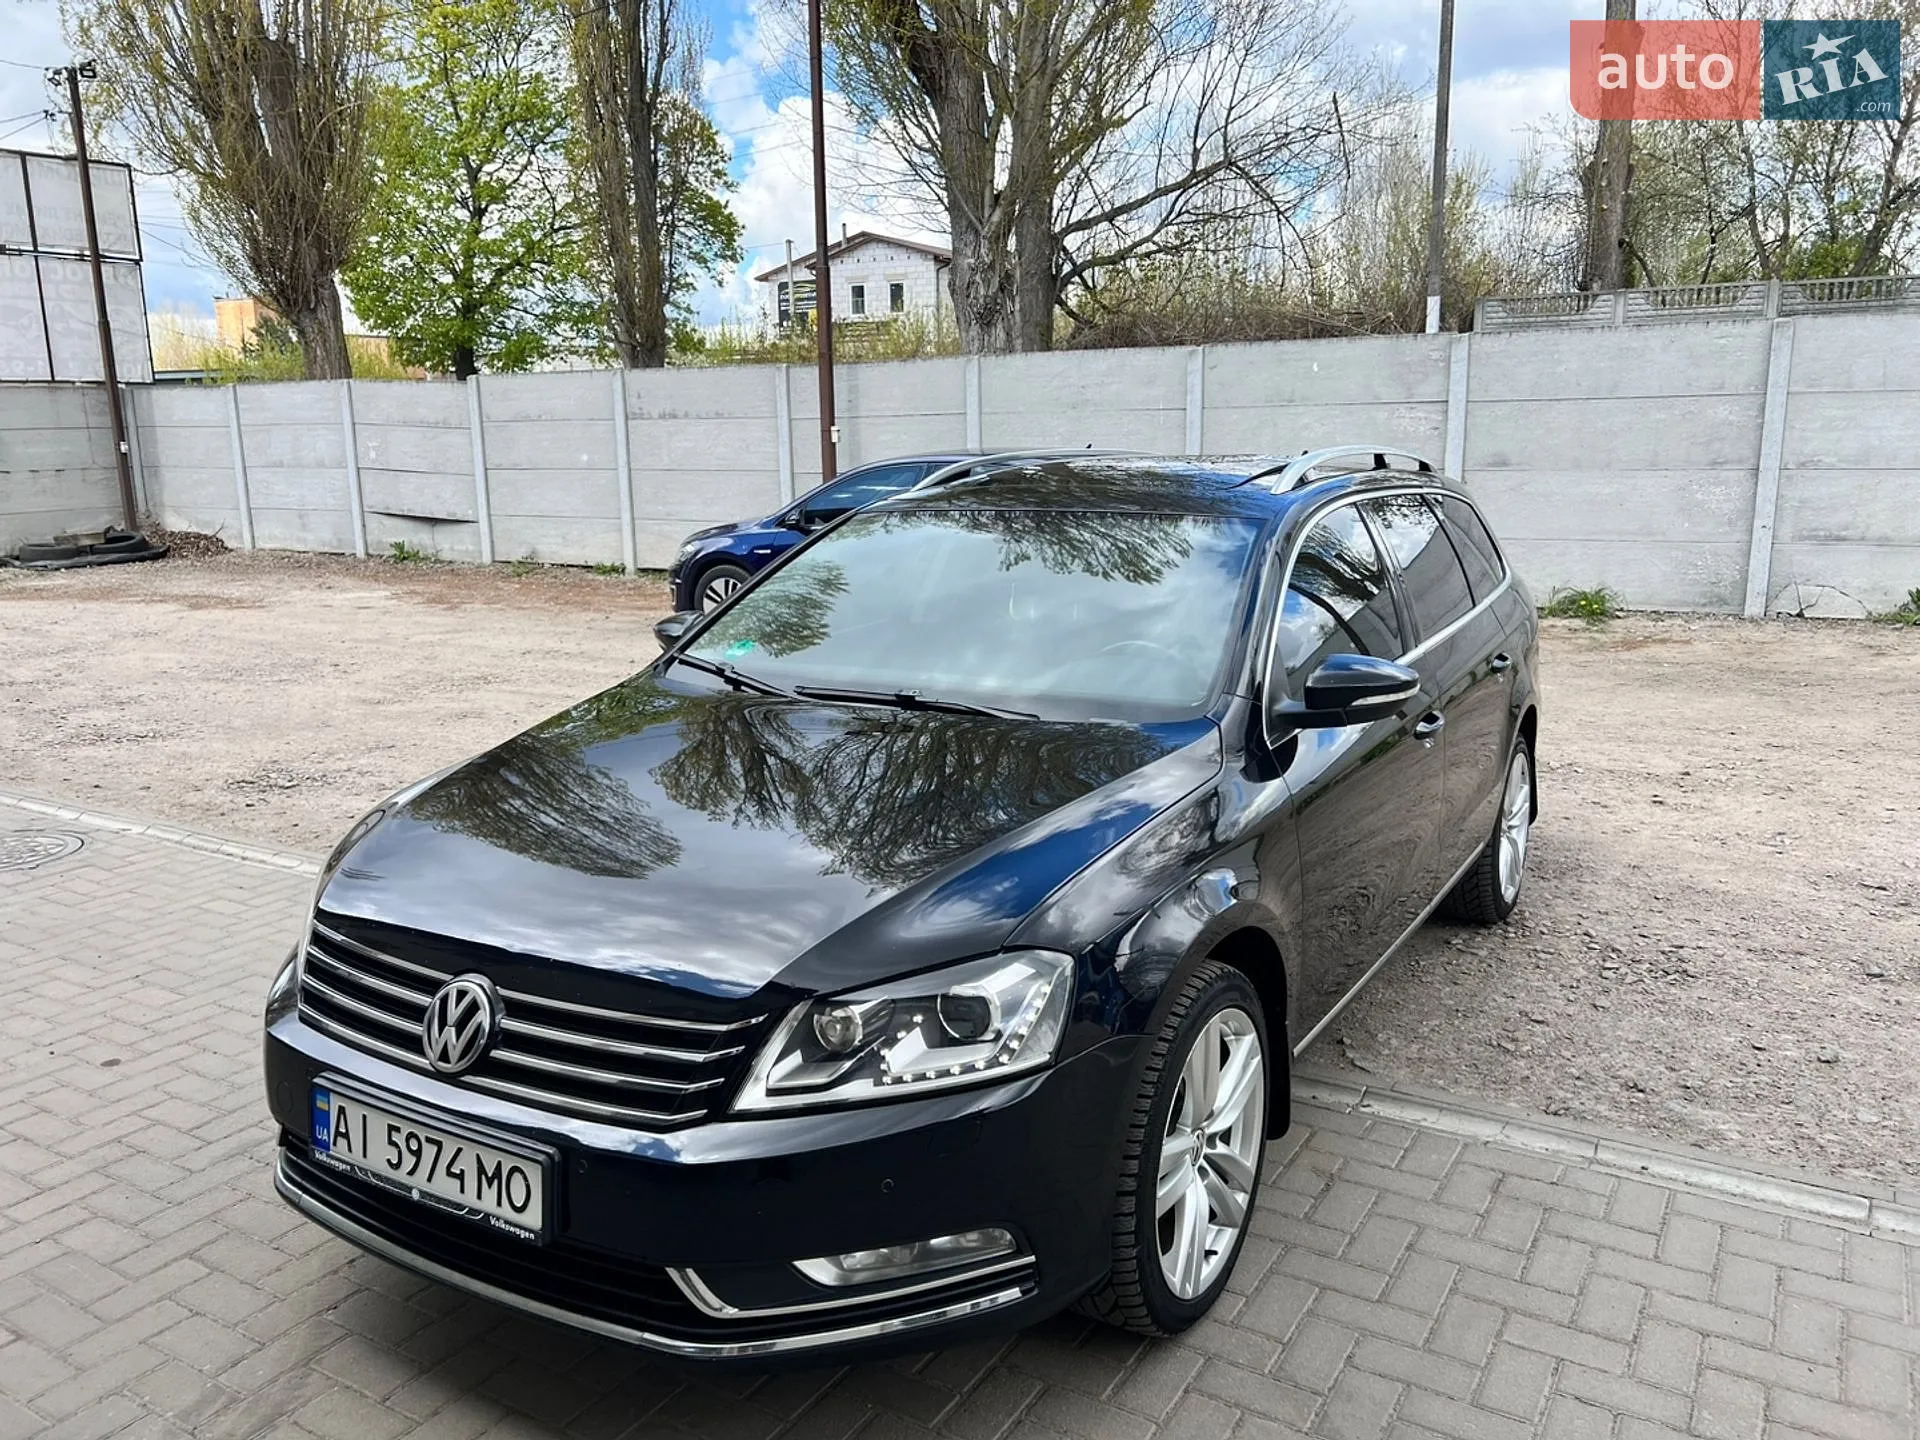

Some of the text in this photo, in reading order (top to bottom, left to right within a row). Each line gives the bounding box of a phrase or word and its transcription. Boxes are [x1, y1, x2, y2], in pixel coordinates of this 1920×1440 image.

[316, 1125, 329, 1142] UA
[314, 1149, 351, 1172] Volkswagen
[332, 1104, 531, 1213] AI 5974 MO
[489, 1215, 535, 1240] Volkswagen
